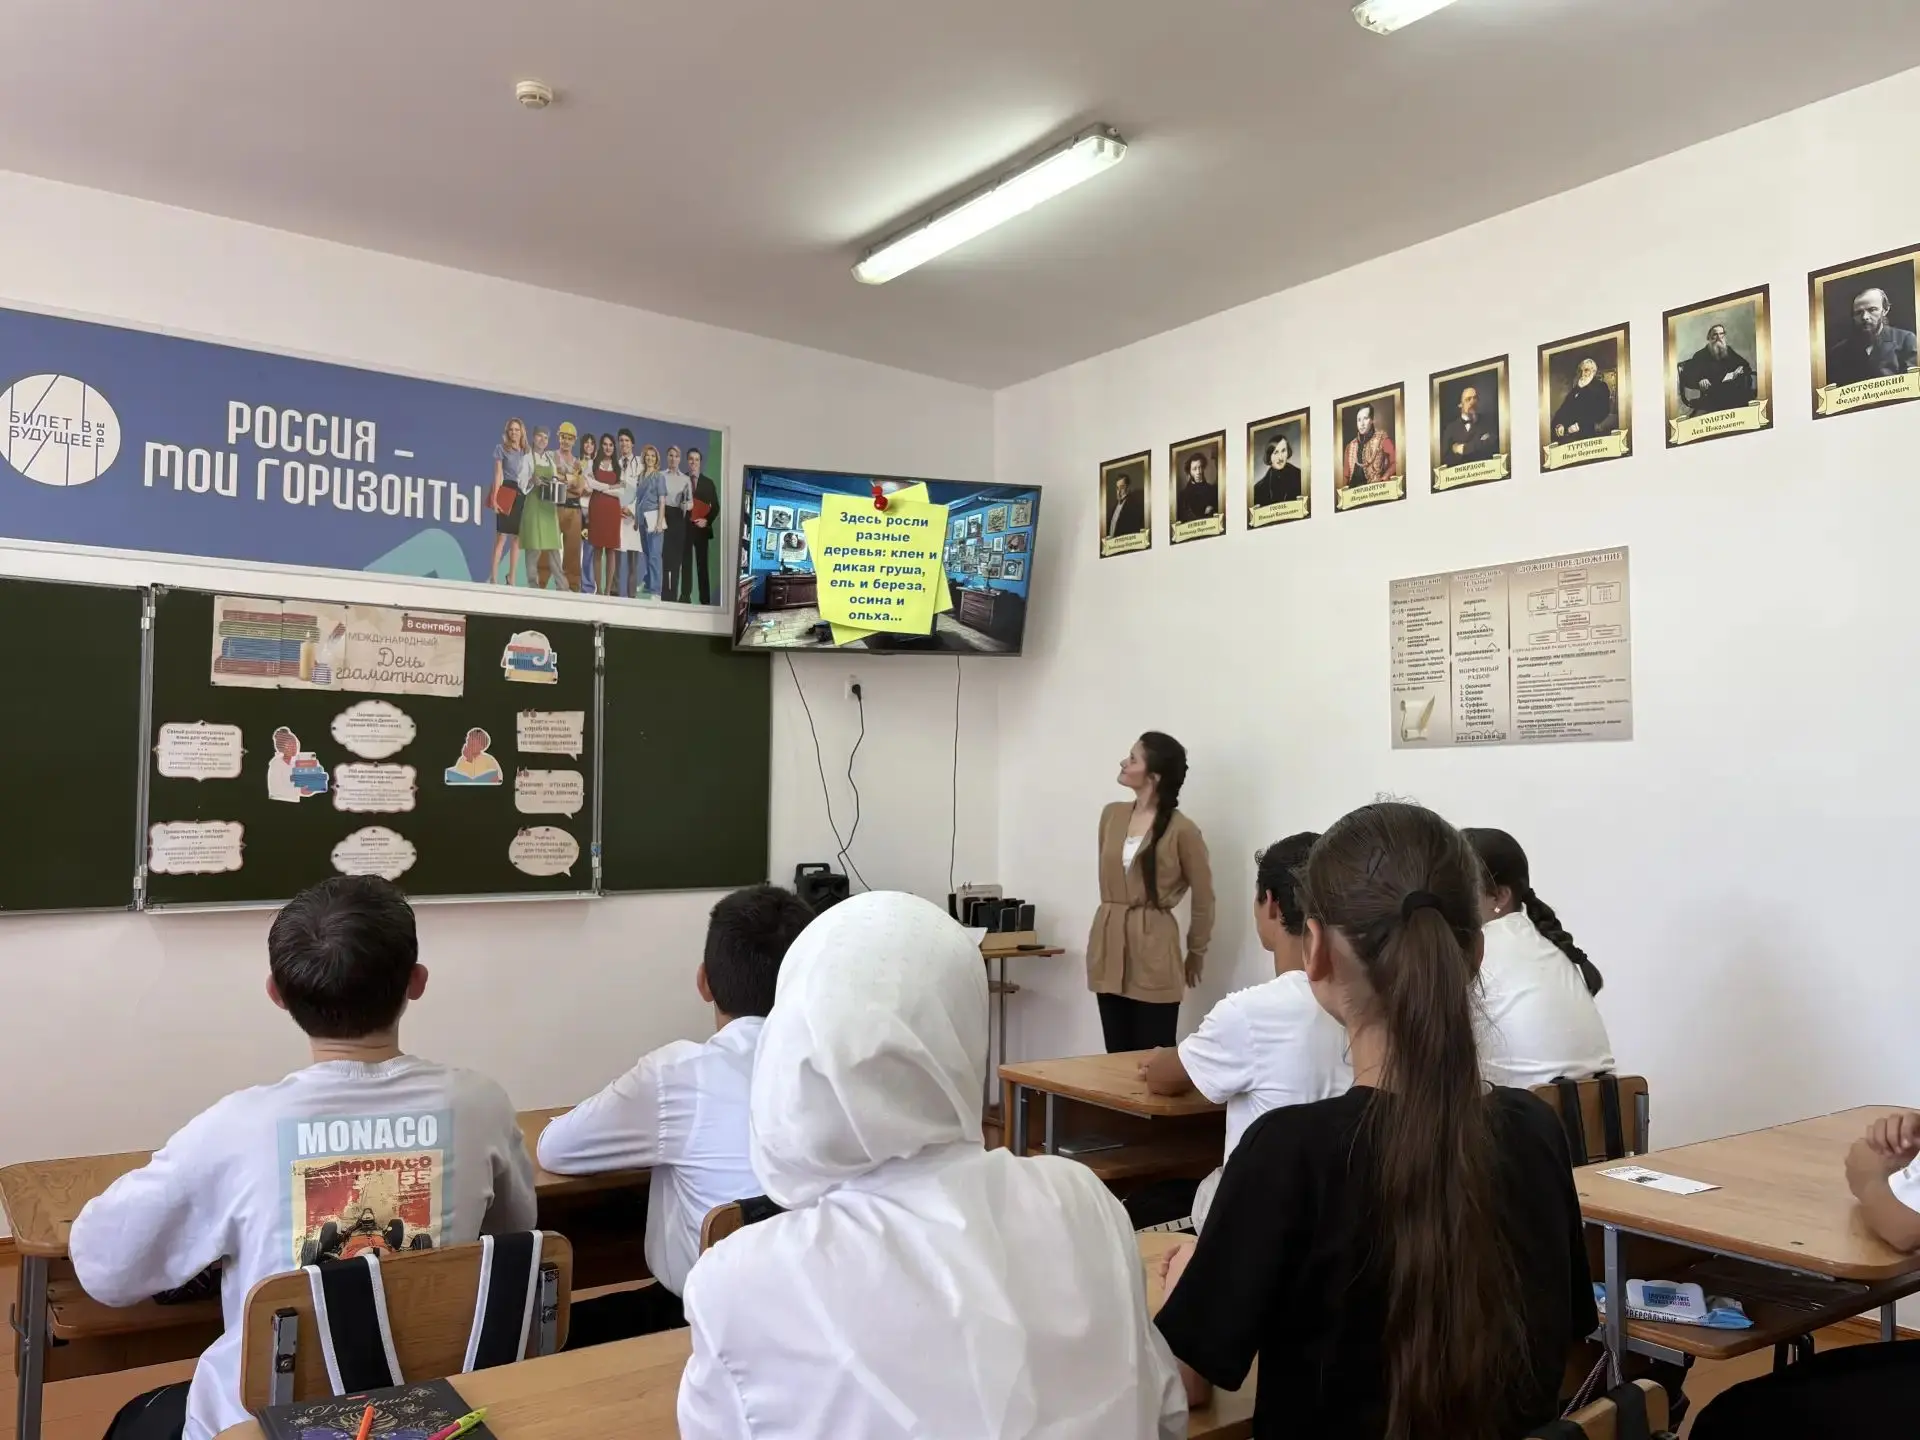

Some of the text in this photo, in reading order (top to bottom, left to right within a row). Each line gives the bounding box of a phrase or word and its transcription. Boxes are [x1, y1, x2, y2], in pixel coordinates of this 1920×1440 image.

[1839, 375, 1905, 398] ДОСТОЕВСКИЙ
[1861, 385, 1911, 403] Михайлович
[10, 411, 92, 433] БИЛЕТ В
[1700, 411, 1736, 426] ТОЛСТОЙ
[1705, 419, 1746, 432] Николаевич
[10, 425, 92, 447] БУДУЩЕЕ
[97, 422, 105, 447] ТВОЕ
[227, 400, 376, 463] РОССИЯ
[143, 441, 483, 526] МОИ ГОРИЗОНТЫ
[840, 511, 928, 528] Здесь росли
[856, 531, 910, 542] разные
[824, 545, 937, 560] деревья: клен и
[1557, 552, 1623, 568] ПРЕДЛОЖЕНИЕ
[833, 562, 926, 577] дикая груша,
[830, 578, 926, 593] ель и береза,
[849, 596, 905, 606] осина и
[848, 610, 902, 621] ольха...
[406, 619, 462, 635] 8 сентября
[348, 632, 440, 647] МЕЖДУНАРОДНЫЙ
[377, 647, 426, 669] День
[336, 667, 463, 687] грамотности
[297, 1115, 438, 1156] MONACO
[339, 1155, 432, 1173] MONACO
[400, 1171, 431, 1186] 55
